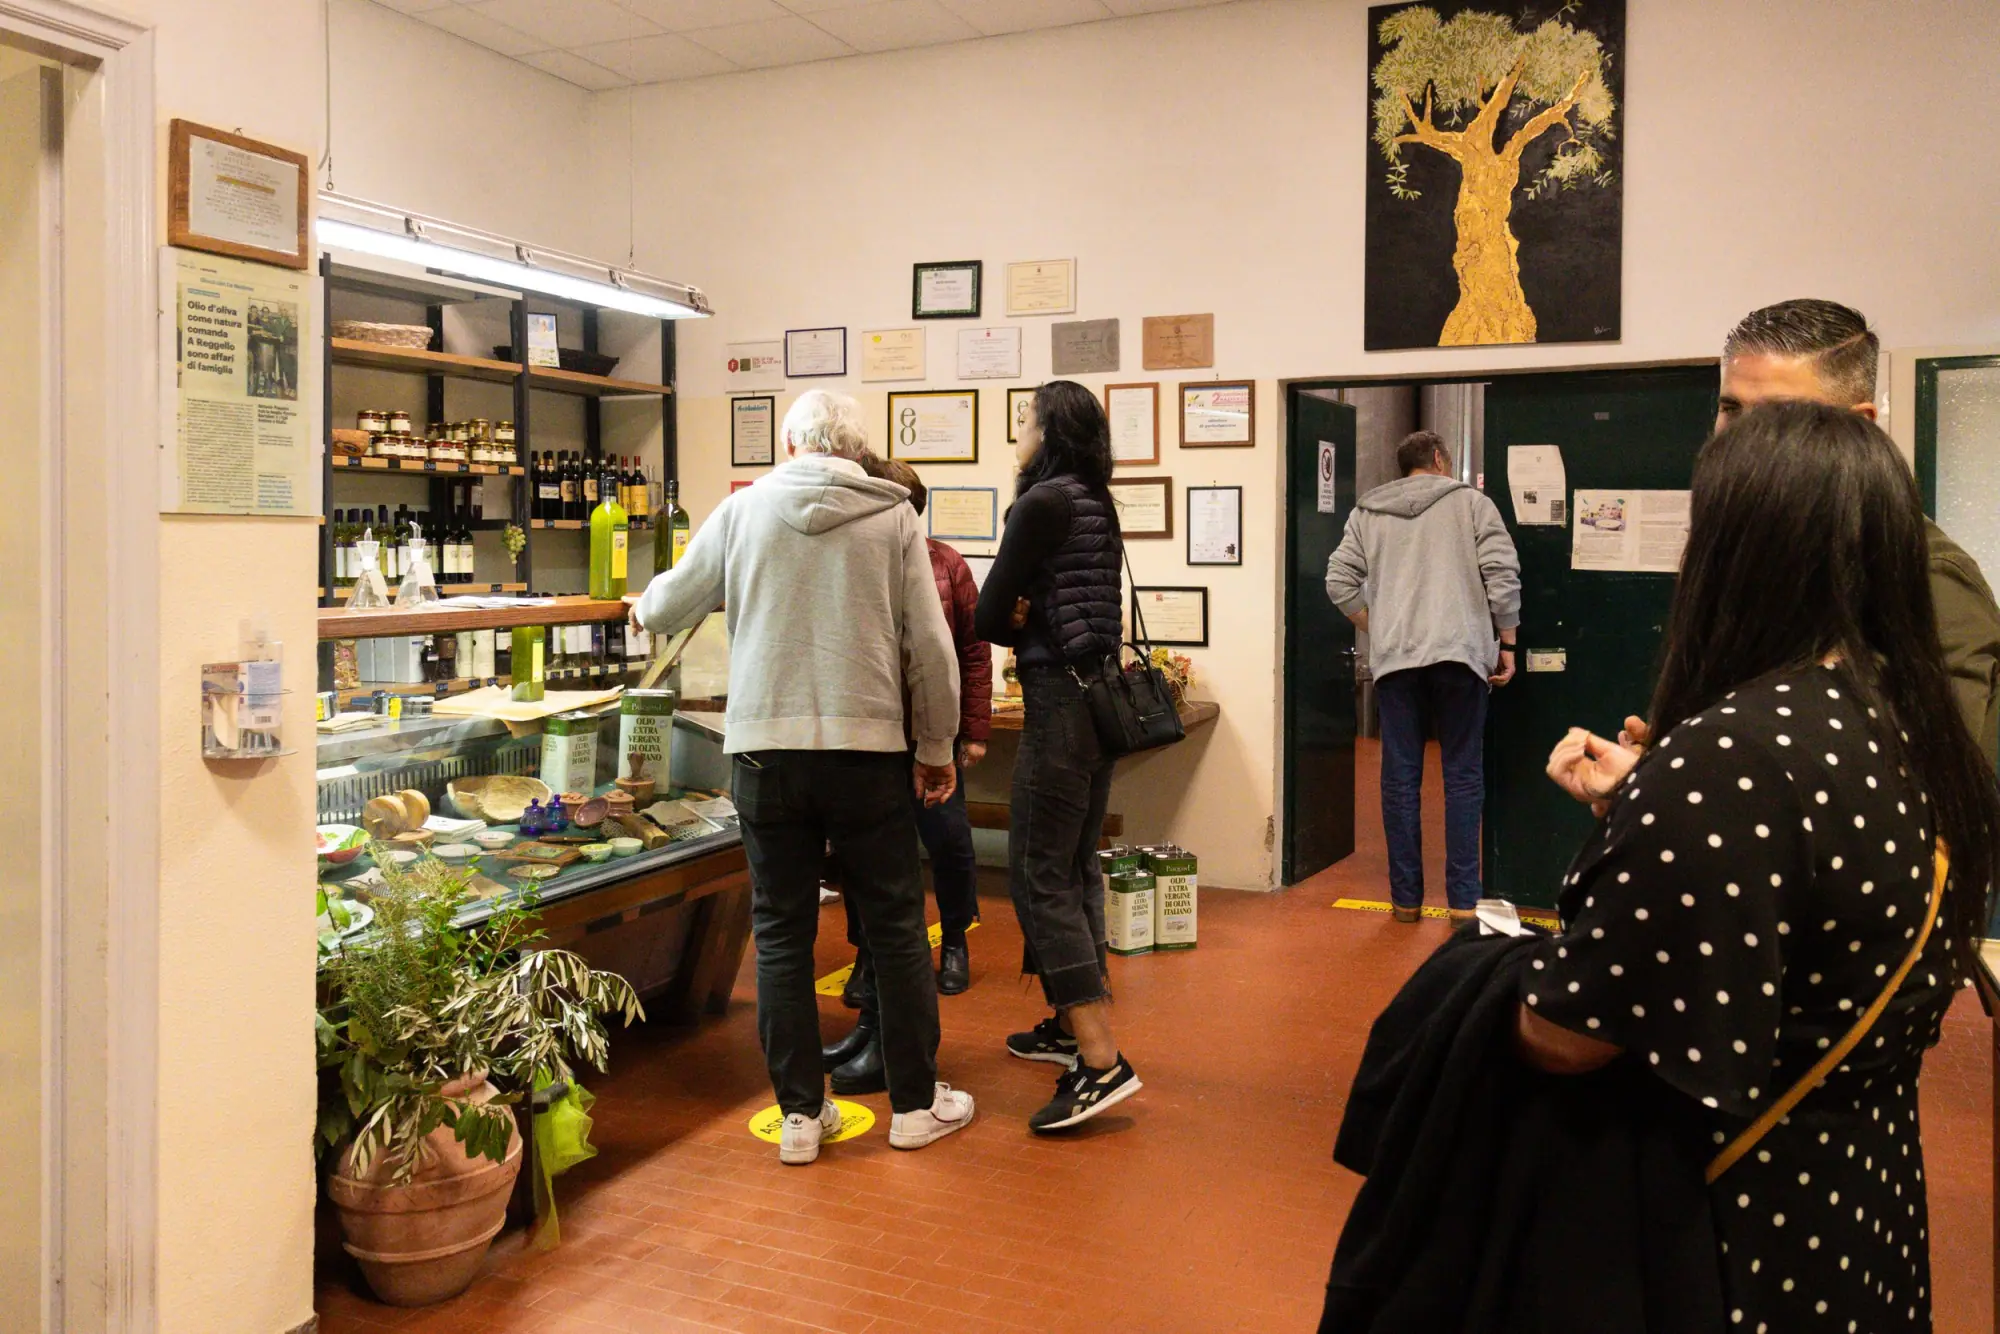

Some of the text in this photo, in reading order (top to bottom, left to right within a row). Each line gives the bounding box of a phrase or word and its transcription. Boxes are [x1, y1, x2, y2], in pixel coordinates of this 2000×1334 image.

[187, 300, 238, 316] Olio d'oliva
[187, 314, 242, 328] come natura
[187, 326, 228, 338] comanda
[187, 336, 236, 351] A Reggello
[187, 350, 234, 362] sono affari
[187, 361, 233, 375] di famiglia
[636, 717, 655, 725] OLIO
[628, 735, 662, 744] VERGINE
[629, 744, 661, 752] DI OLIVA
[1164, 892, 1191, 900] VERGINE
[1164, 908, 1192, 916] ITALIANO
